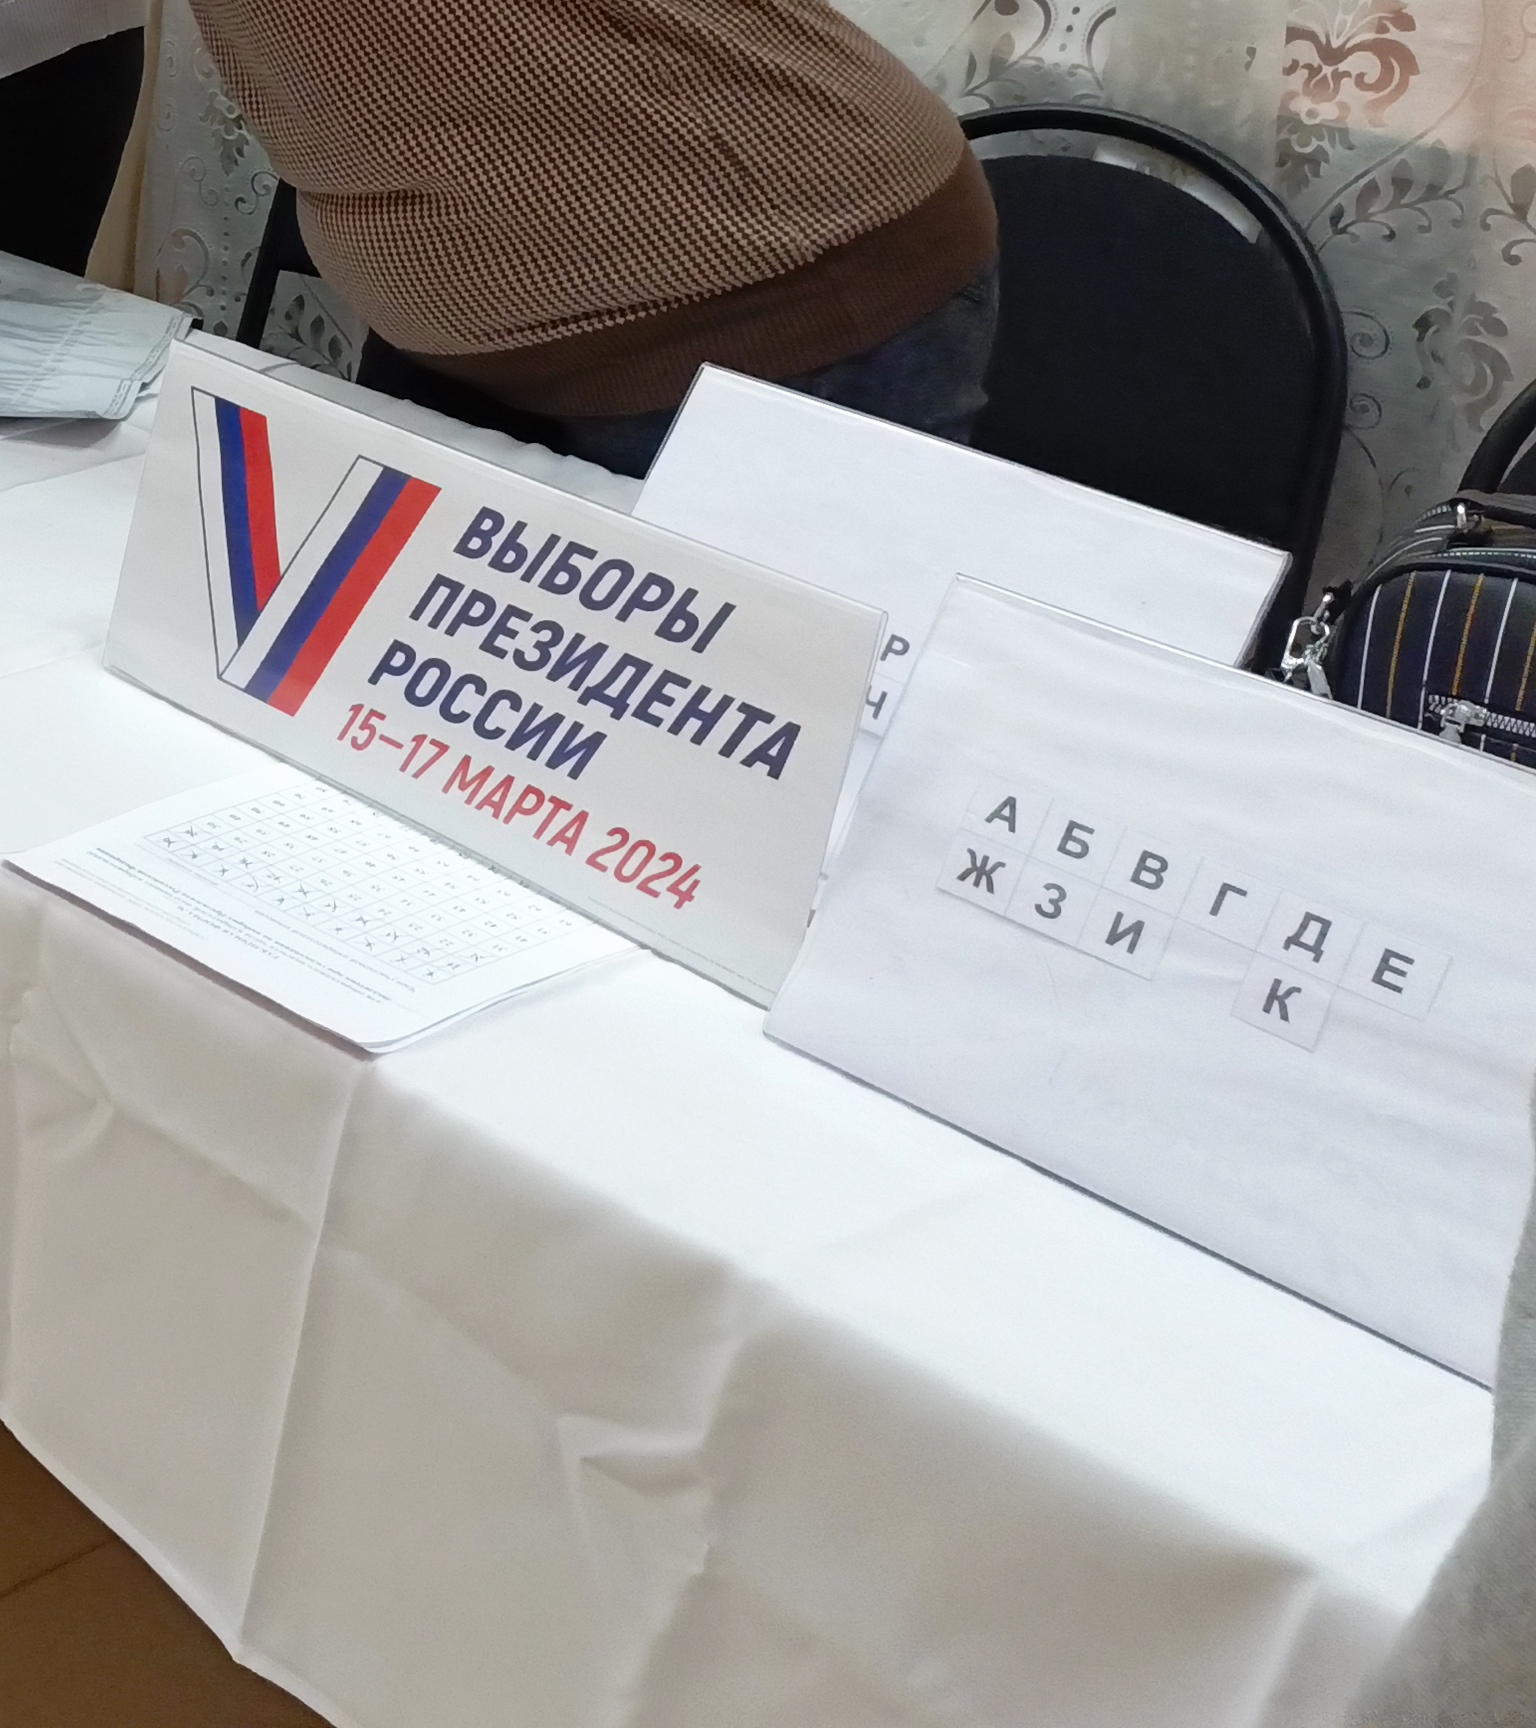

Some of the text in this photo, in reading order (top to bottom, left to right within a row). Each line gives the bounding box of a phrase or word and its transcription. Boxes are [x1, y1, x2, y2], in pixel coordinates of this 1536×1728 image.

[453, 506, 737, 654] ВЫБОРЫ
[879, 633, 910, 662] Р
[367, 639, 608, 781] РОССИИ
[408, 572, 802, 781] ПРЕЗИДЕНТА
[441, 754, 589, 857] МАРТА
[585, 826, 703, 910] 2024
[984, 795, 1416, 994] А Б В Г Д Е
[956, 847, 1007, 894] Ж
[1105, 911, 1146, 955] И
[1261, 978, 1302, 1023] К
